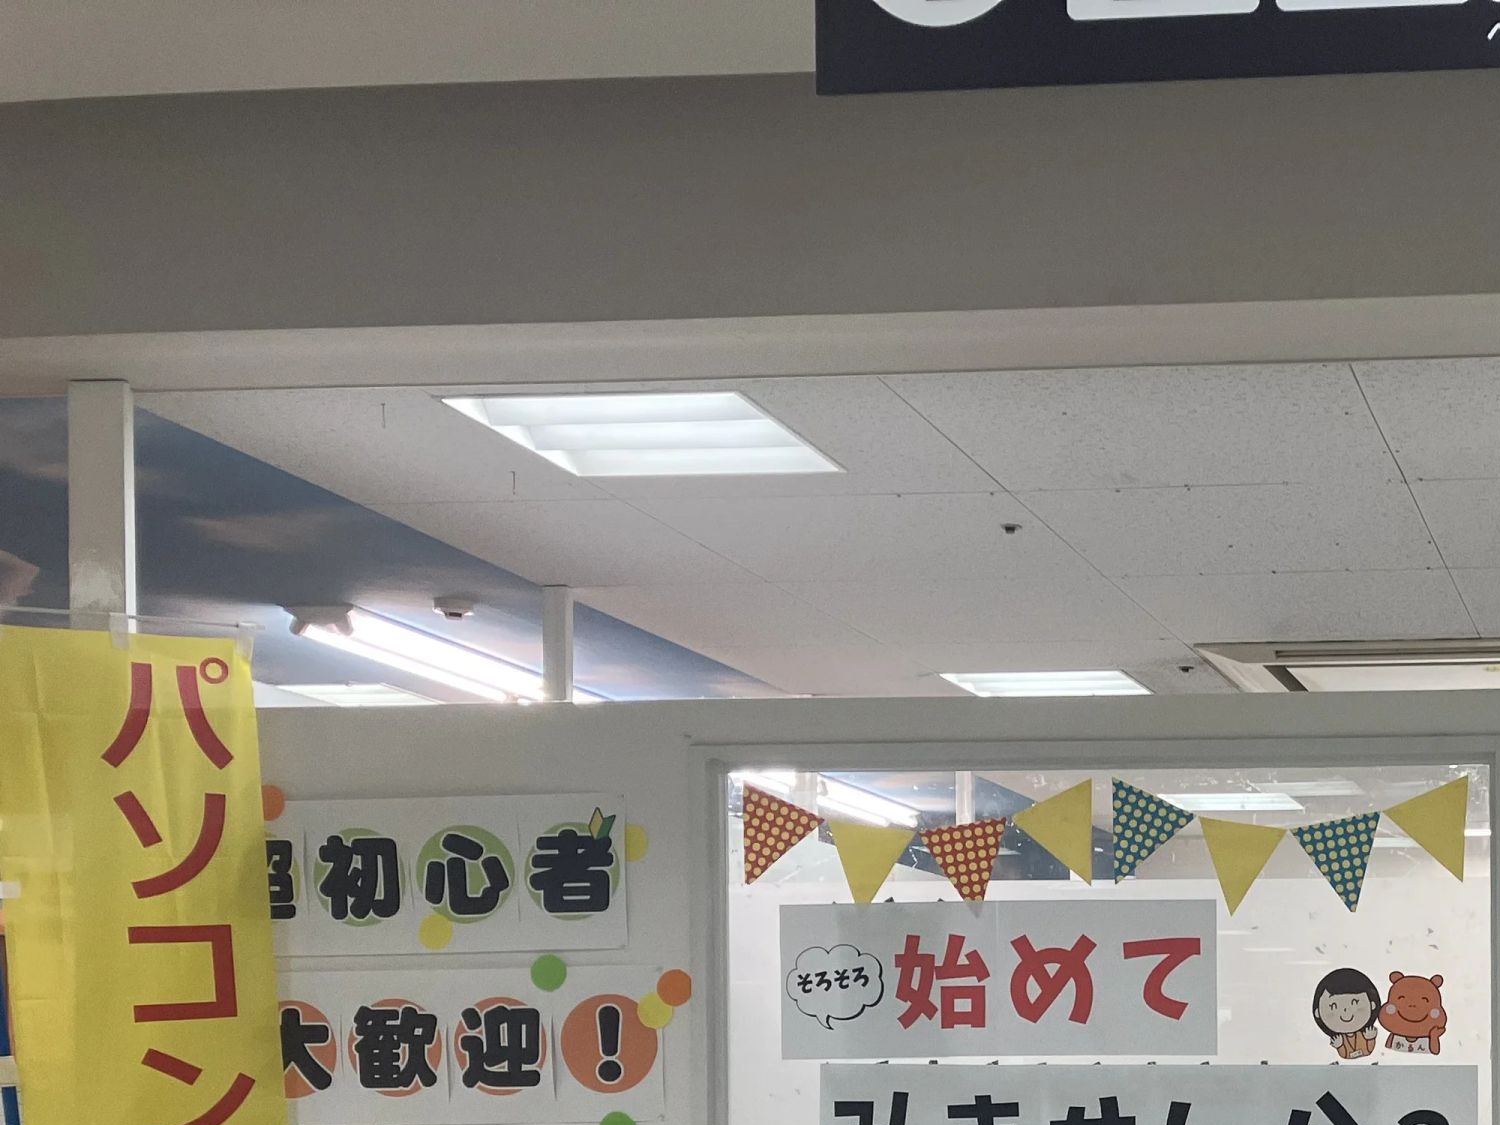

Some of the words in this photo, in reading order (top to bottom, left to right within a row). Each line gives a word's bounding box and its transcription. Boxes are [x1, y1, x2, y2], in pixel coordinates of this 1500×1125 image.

[797, 966, 870, 994] そろそろ
[894, 932, 1202, 1030] 始めて
